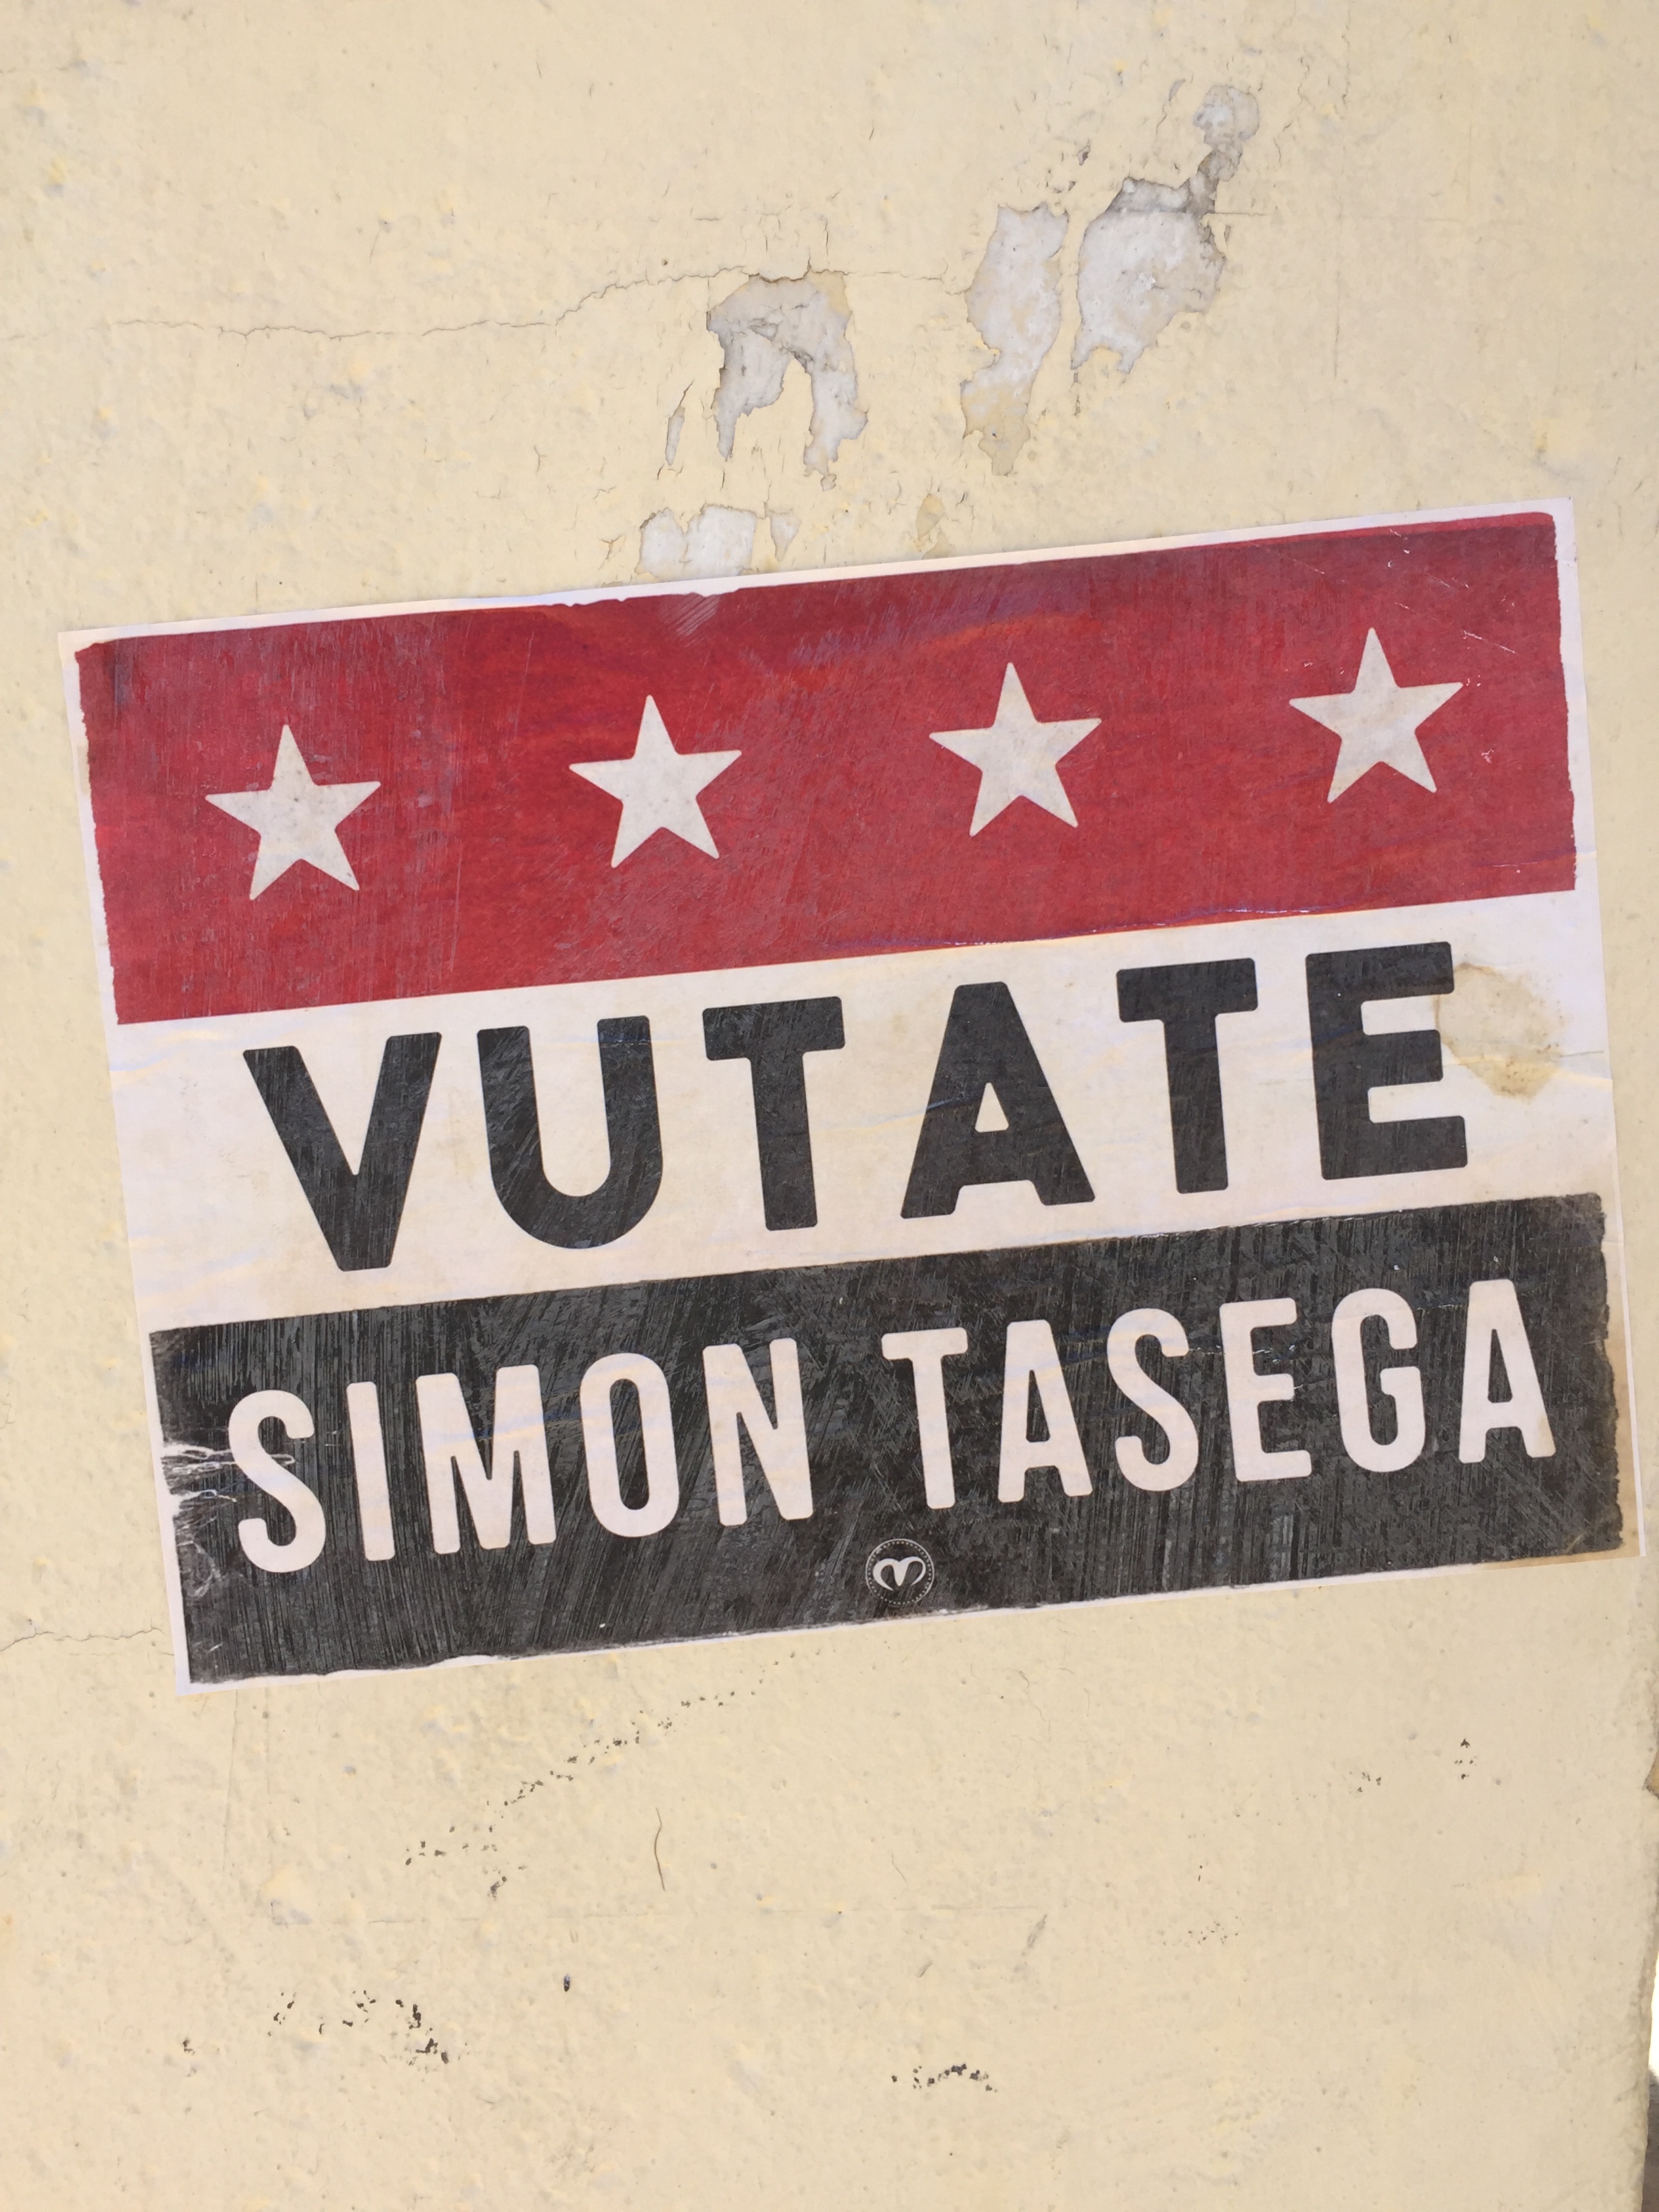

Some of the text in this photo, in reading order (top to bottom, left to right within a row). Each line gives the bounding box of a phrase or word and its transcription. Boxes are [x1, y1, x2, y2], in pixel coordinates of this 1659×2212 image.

[243, 941, 1468, 1272] VUTATE
[228, 1279, 1556, 1572] SIMON TASEGA
